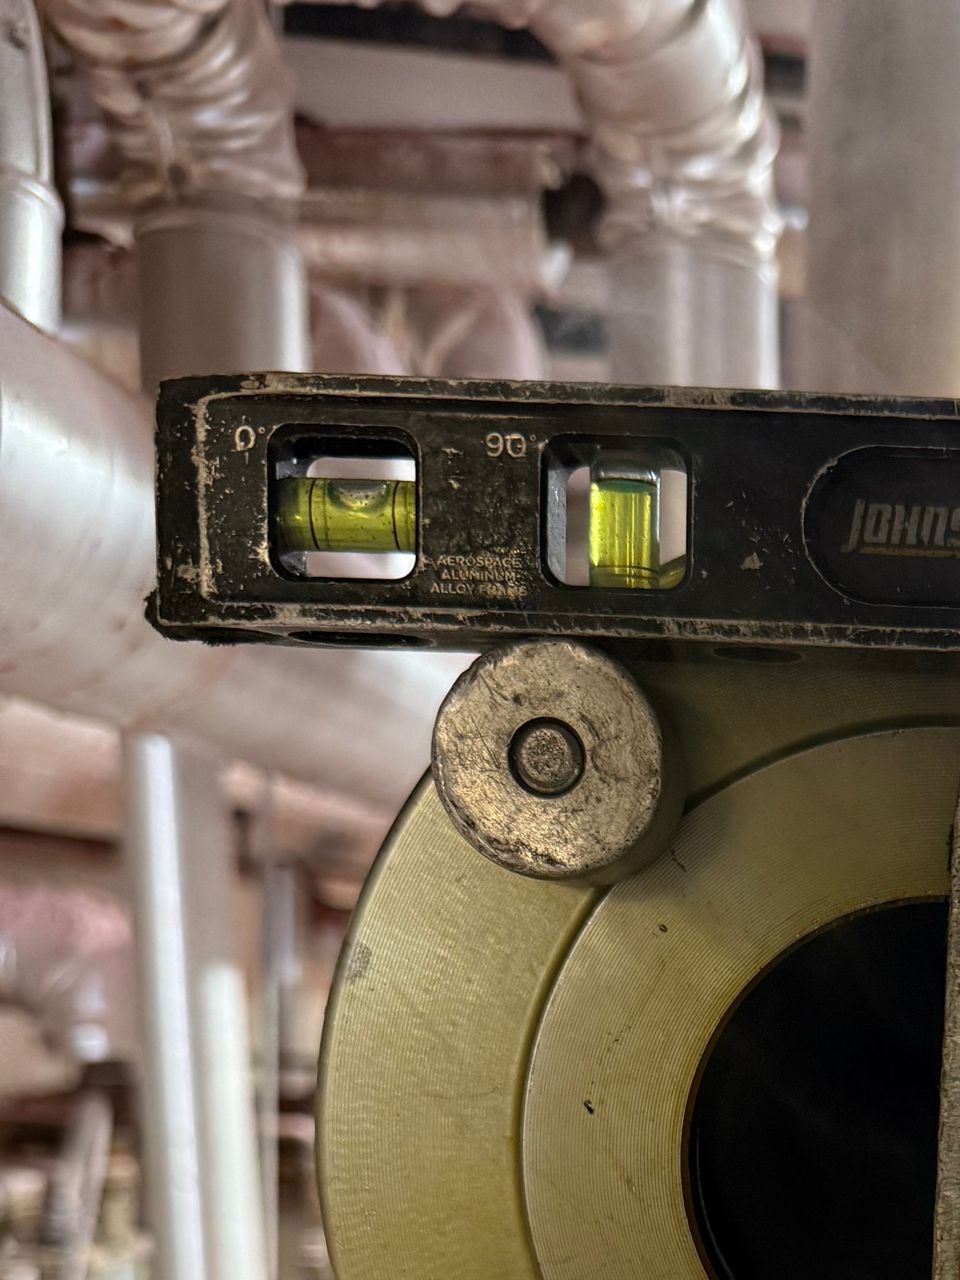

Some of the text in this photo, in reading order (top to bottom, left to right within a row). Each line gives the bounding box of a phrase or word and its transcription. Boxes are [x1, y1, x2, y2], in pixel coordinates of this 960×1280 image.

[437, 554, 523, 569] AEROSPACE
[440, 569, 517, 582] ALUMINUM
[431, 582, 475, 596] ALLOY
